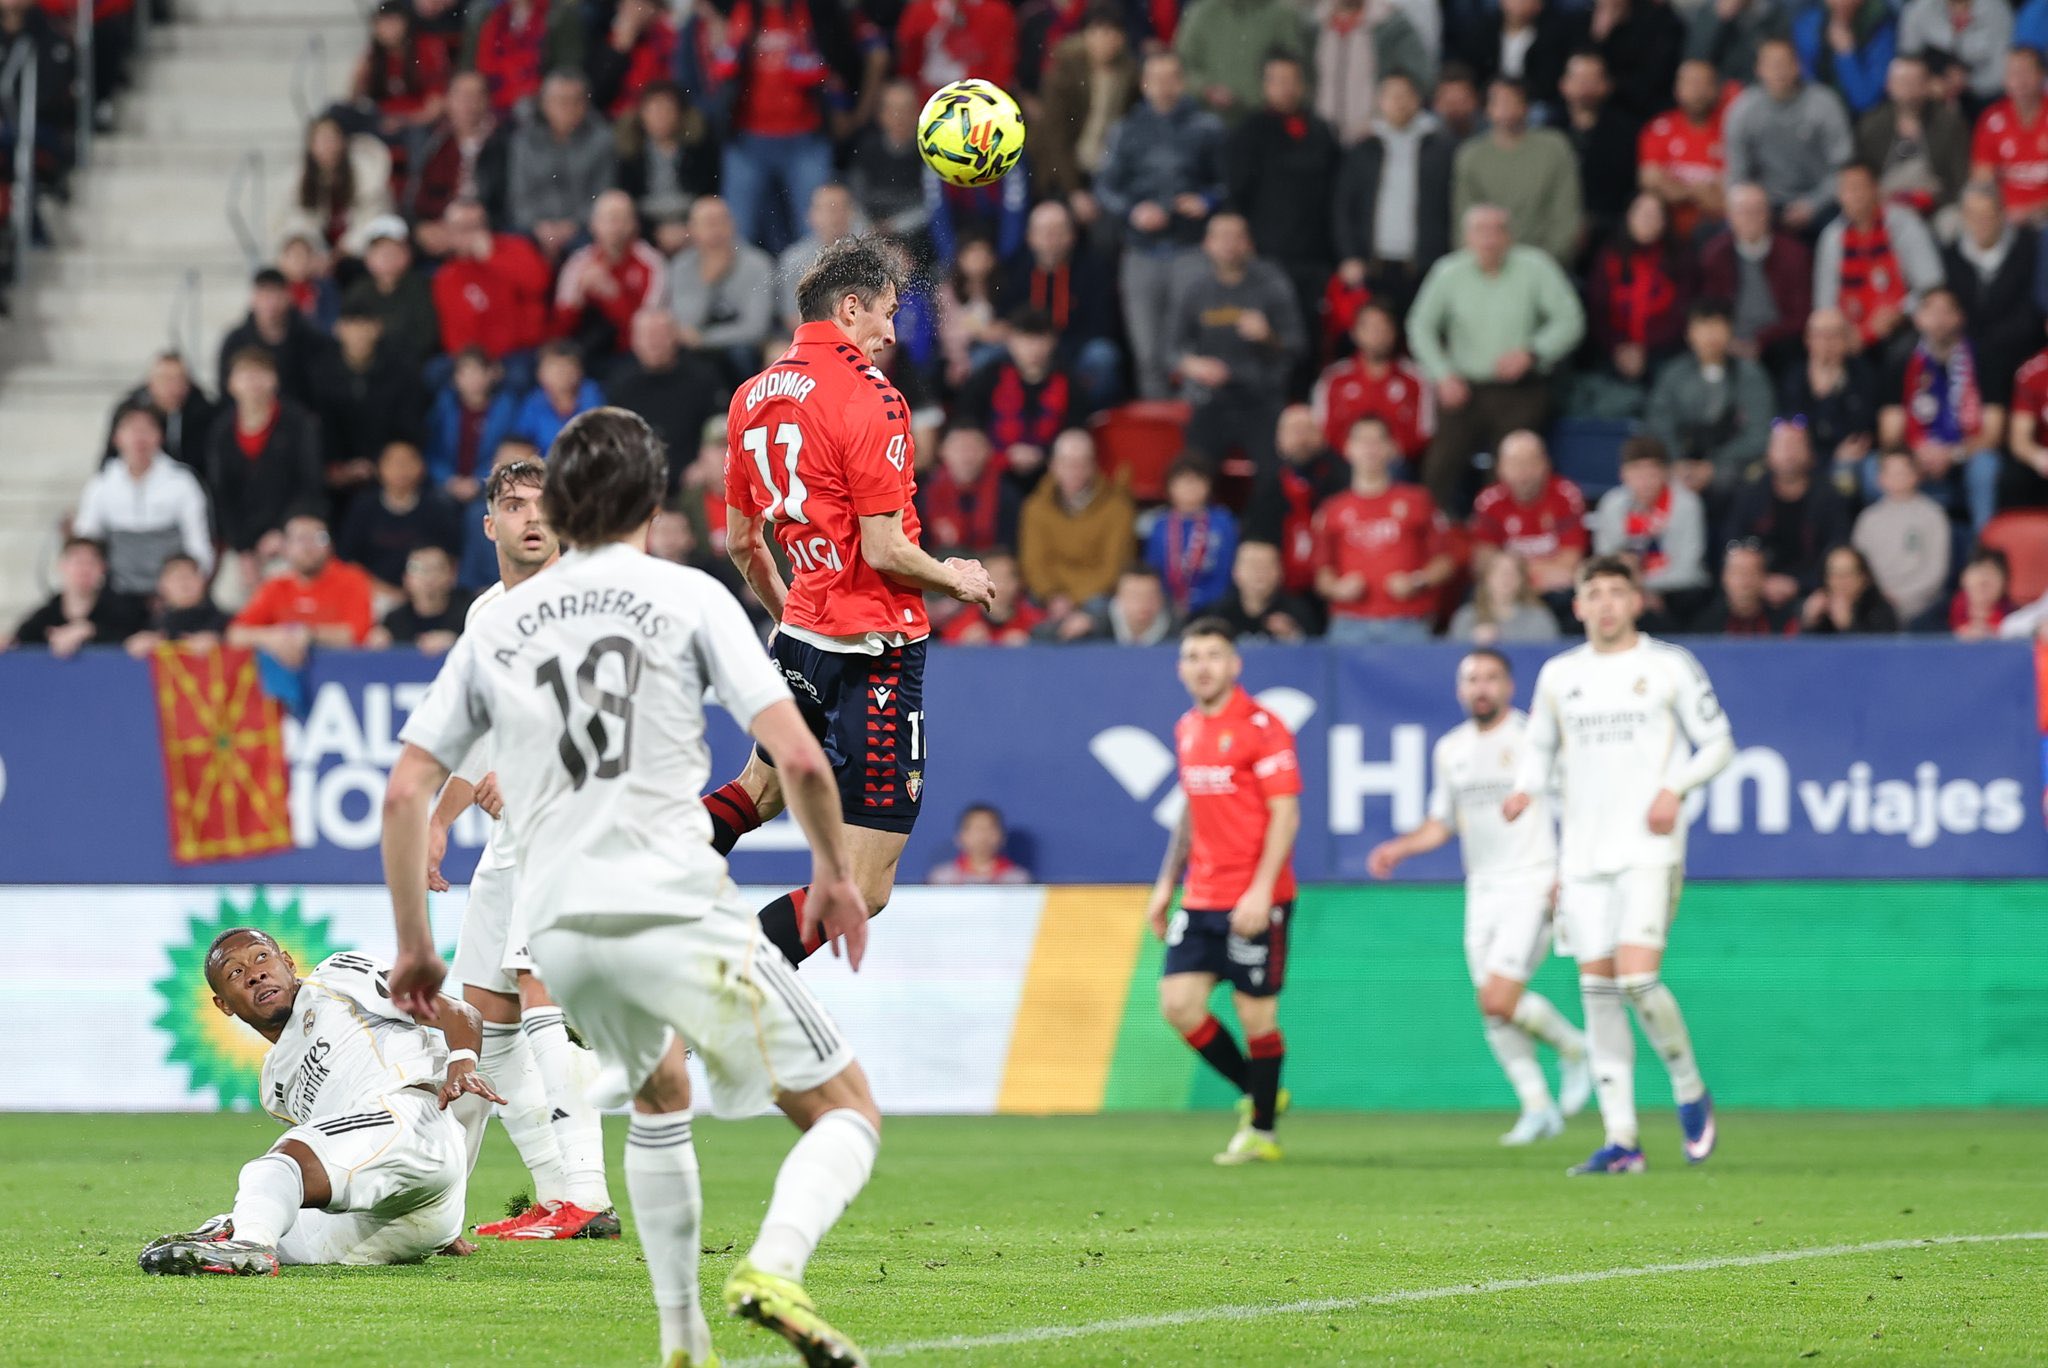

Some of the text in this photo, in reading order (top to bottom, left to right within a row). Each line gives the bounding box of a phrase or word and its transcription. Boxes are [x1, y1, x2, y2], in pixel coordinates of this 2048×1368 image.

[536, 636, 643, 792] 18
[907, 710, 927, 761] 1
[1798, 760, 2026, 850] viajes
